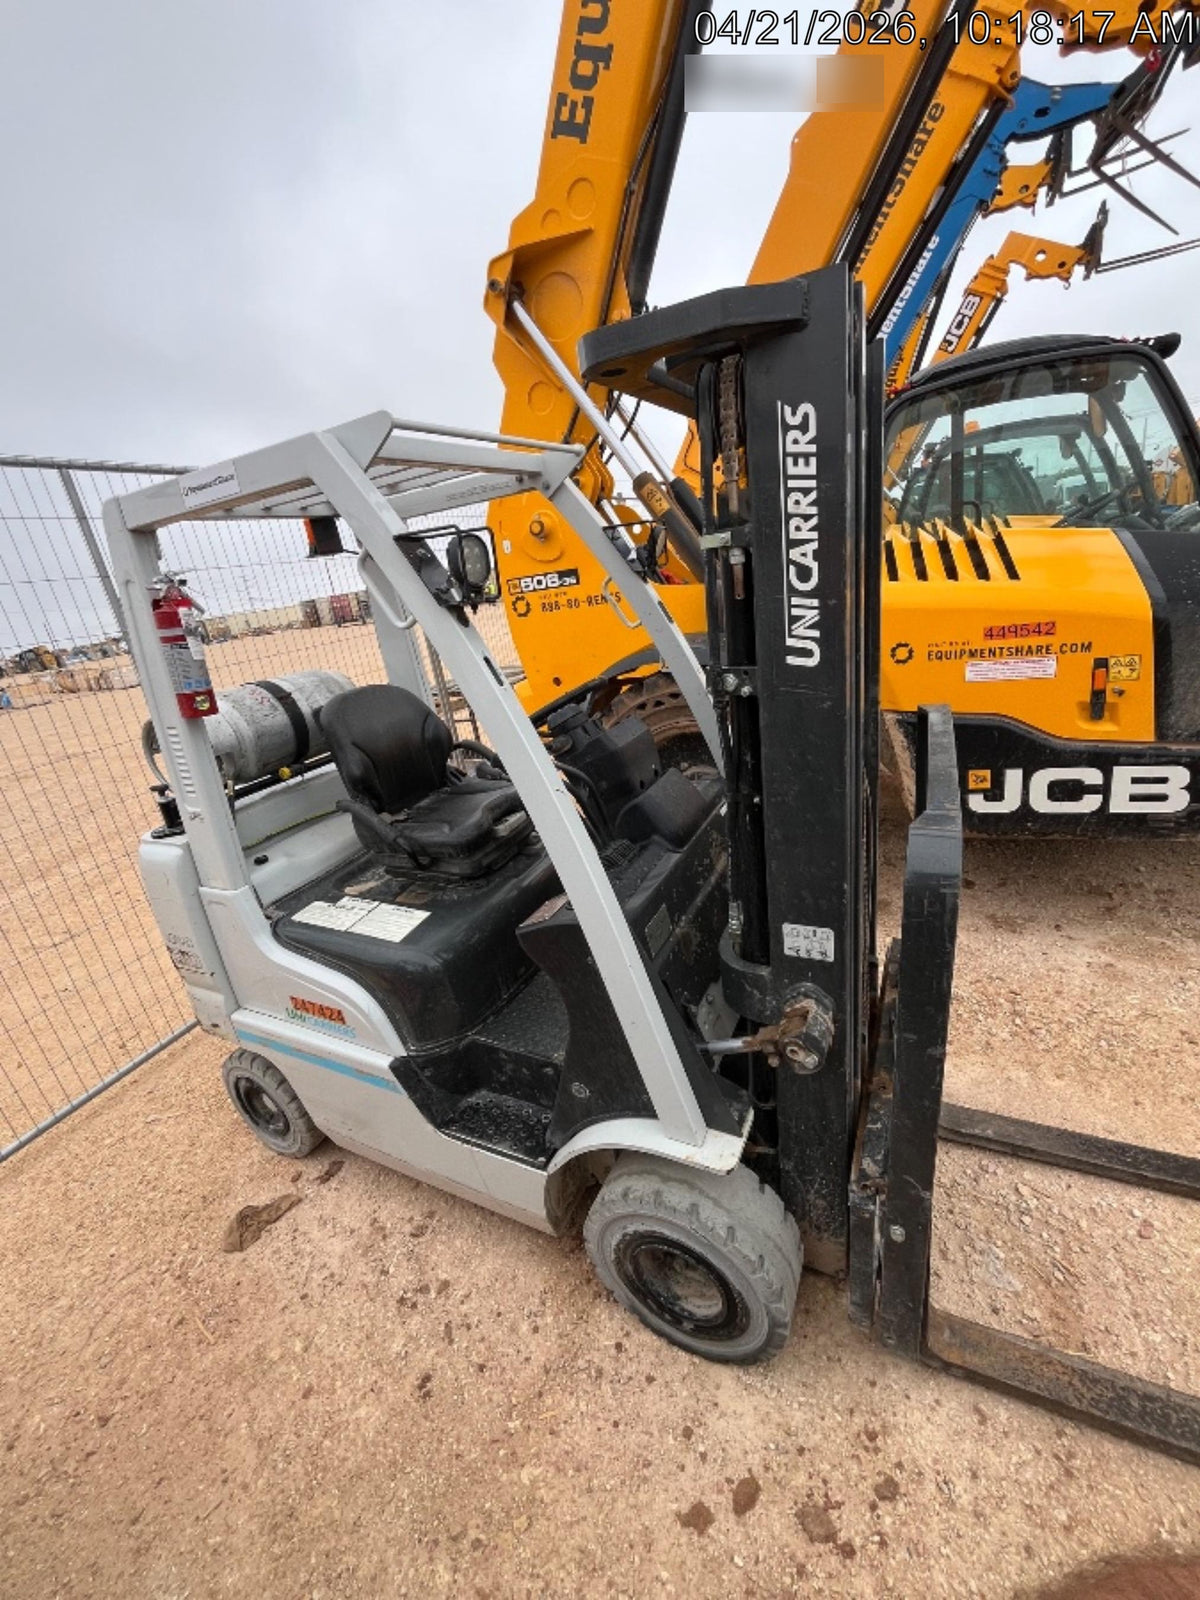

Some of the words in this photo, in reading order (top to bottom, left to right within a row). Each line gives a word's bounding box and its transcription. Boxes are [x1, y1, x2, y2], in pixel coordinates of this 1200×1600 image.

[946, 294, 982, 354] JCB
[777, 400, 822, 668] UNICARRIERS
[927, 641, 1093, 662] EQUIPMENTSHARE.COM
[983, 621, 1057, 640] 449542
[968, 766, 1191, 814] JCB
